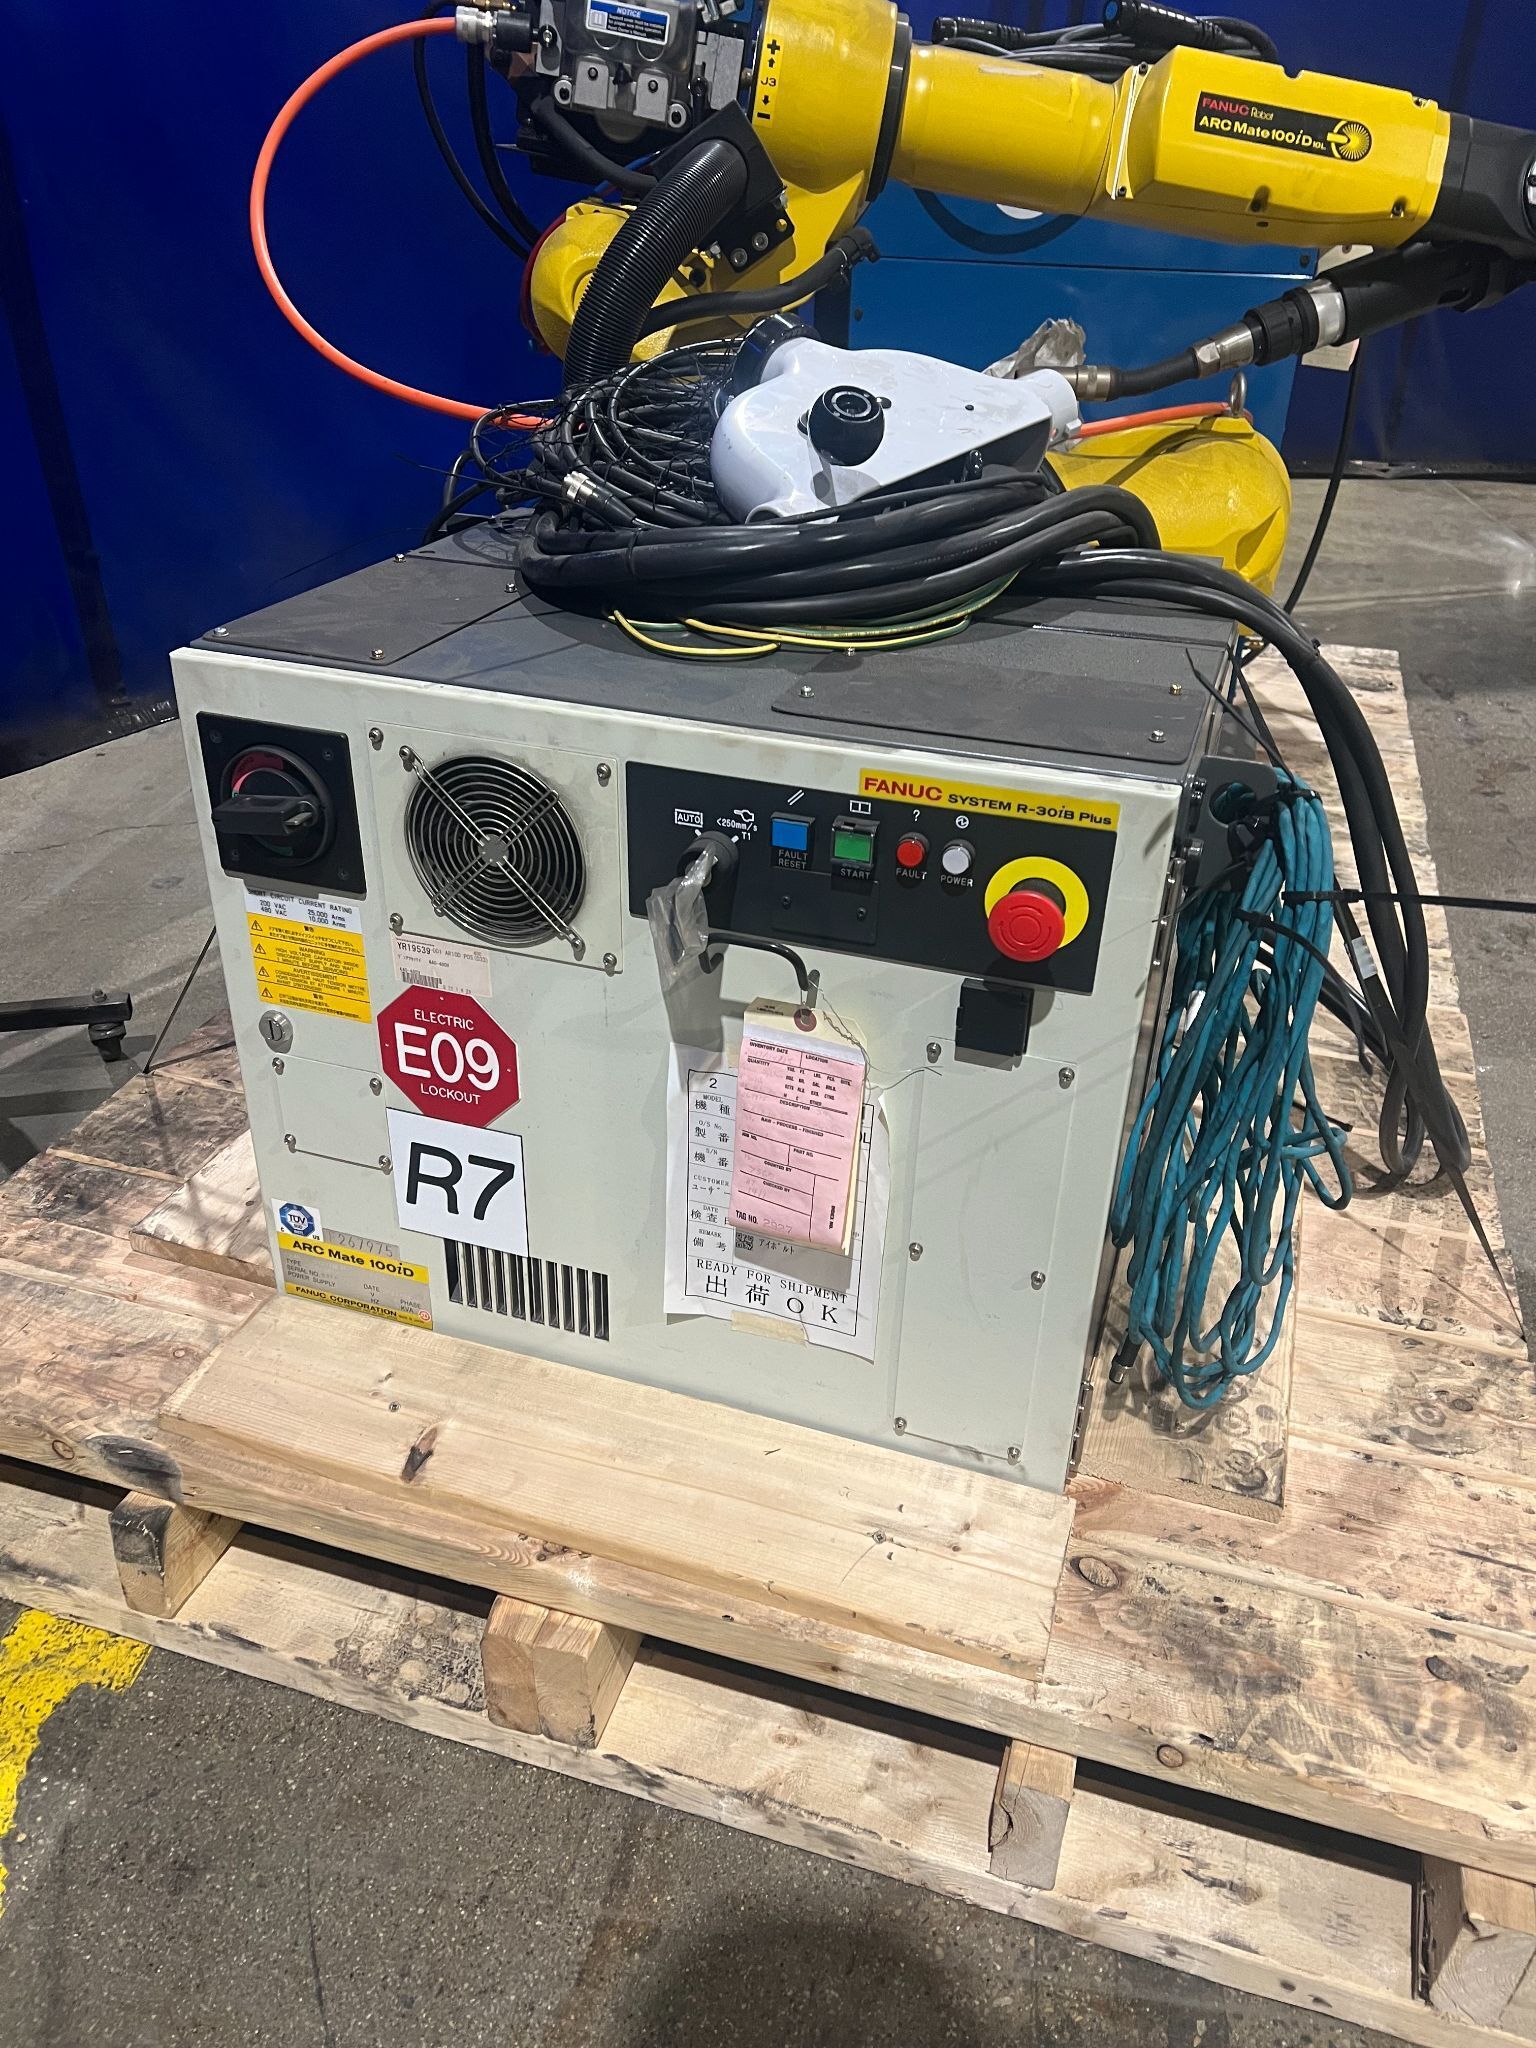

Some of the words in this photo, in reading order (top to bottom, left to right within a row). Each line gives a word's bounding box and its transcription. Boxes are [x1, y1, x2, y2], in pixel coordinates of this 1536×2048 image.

[616, 6, 641, 18] NOTICE
[760, 76, 777, 88] J3
[1201, 97, 1250, 116] FANUC
[1199, 115, 1233, 132] ARC
[1233, 121, 1271, 139] Mate
[863, 776, 943, 801] FANUC
[947, 793, 1013, 812] SYSTEM
[1016, 804, 1075, 820] R-30iB
[1078, 812, 1113, 826] Plus
[677, 812, 701, 824] AUTO
[741, 831, 752, 841] T1
[778, 848, 809, 861] FAULT
[778, 857, 807, 871] RESET
[840, 868, 871, 880] START
[895, 867, 928, 881] FAULT
[940, 874, 975, 888] POWER
[270, 891, 295, 903] CIRCUIT
[299, 897, 326, 909] CURRENT
[329, 904, 353, 915] RATING
[273, 902, 287, 911] VAC
[275, 909, 288, 917] VAC
[414, 1008, 475, 1031] ELECTRIC
[749, 1041, 776, 1052] INVENTORY
[393, 1021, 500, 1092] E09
[747, 1057, 770, 1067] QUANTITY
[805, 1054, 829, 1064] LOCATION
[708, 1077, 718, 1089] 2
[419, 1083, 481, 1105] LOCKOUT
[702, 1093, 724, 1104] MODEL
[779, 1099, 811, 1111] DESCRIPTION
[776, 1121, 798, 1131] PROCESS
[405, 1141, 516, 1221] R7
[693, 1174, 730, 1187] CUSTOMER
[702, 1204, 719, 1214] DATE
[735, 1209, 748, 1221] TAG
[748, 1214, 759, 1225] NO.
[698, 1228, 723, 1239] REMARK
[286, 1258, 302, 1267] TYPE
[292, 1239, 325, 1256] ARC
[327, 1248, 366, 1266] Mate
[370, 1259, 415, 1278] 100iD
[286, 1264, 308, 1276] SERIAL
[287, 1271, 311, 1282] POWER
[311, 1275, 336, 1288] SUPPLY
[695, 1257, 739, 1276] READY
[746, 1269, 772, 1285] FOR
[779, 1278, 849, 1305] SHIPMENT
[362, 1283, 381, 1293] DATE
[295, 1286, 327, 1300] FANUC
[329, 1295, 398, 1317] CORPORATION
[400, 1298, 422, 1309] PHASE
